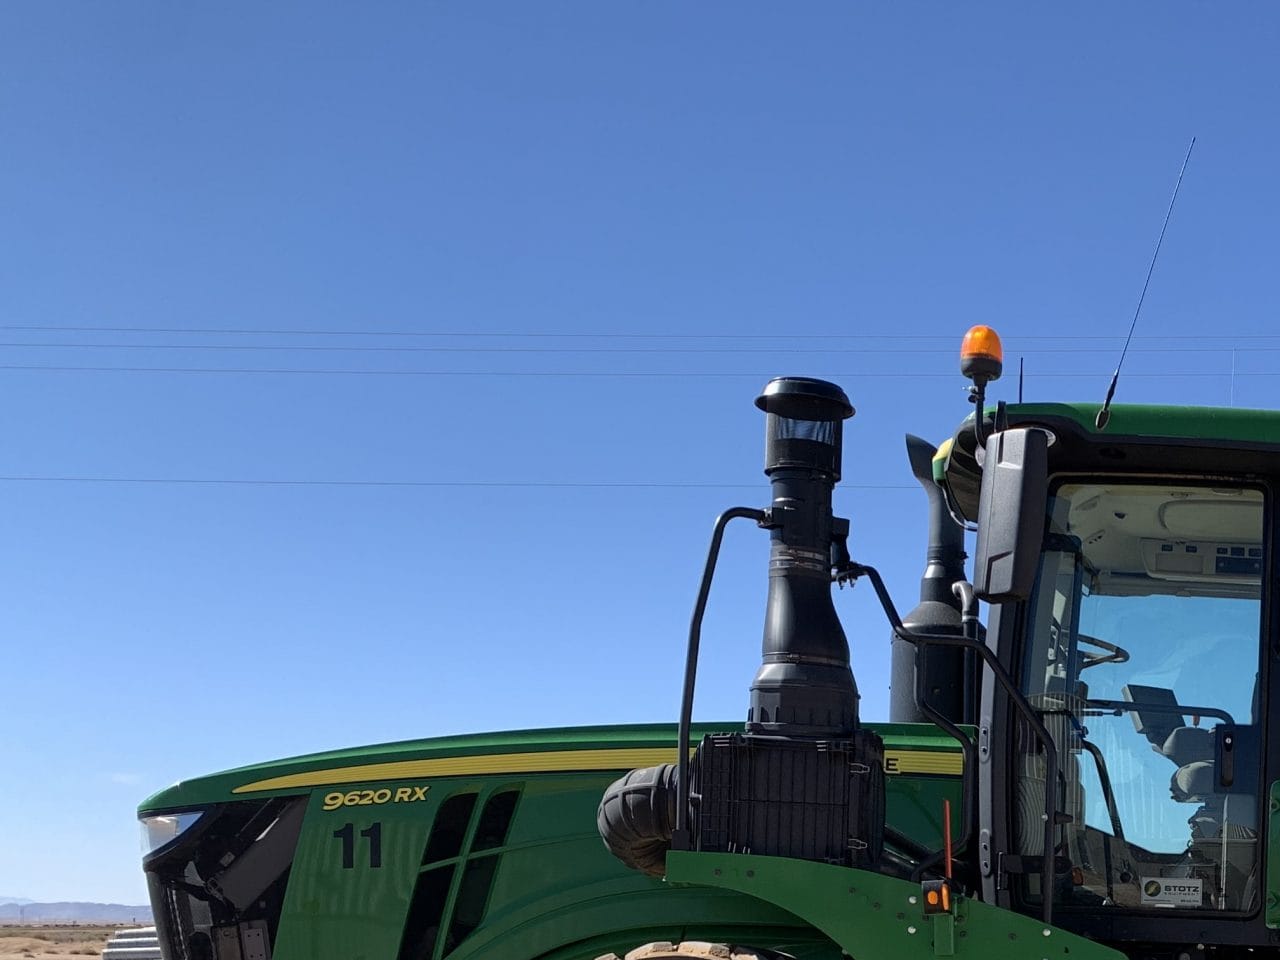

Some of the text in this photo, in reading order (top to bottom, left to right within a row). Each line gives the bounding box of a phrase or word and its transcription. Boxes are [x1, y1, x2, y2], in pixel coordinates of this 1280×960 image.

[322, 786, 430, 811] 9620 RX
[333, 822, 382, 869] 11
